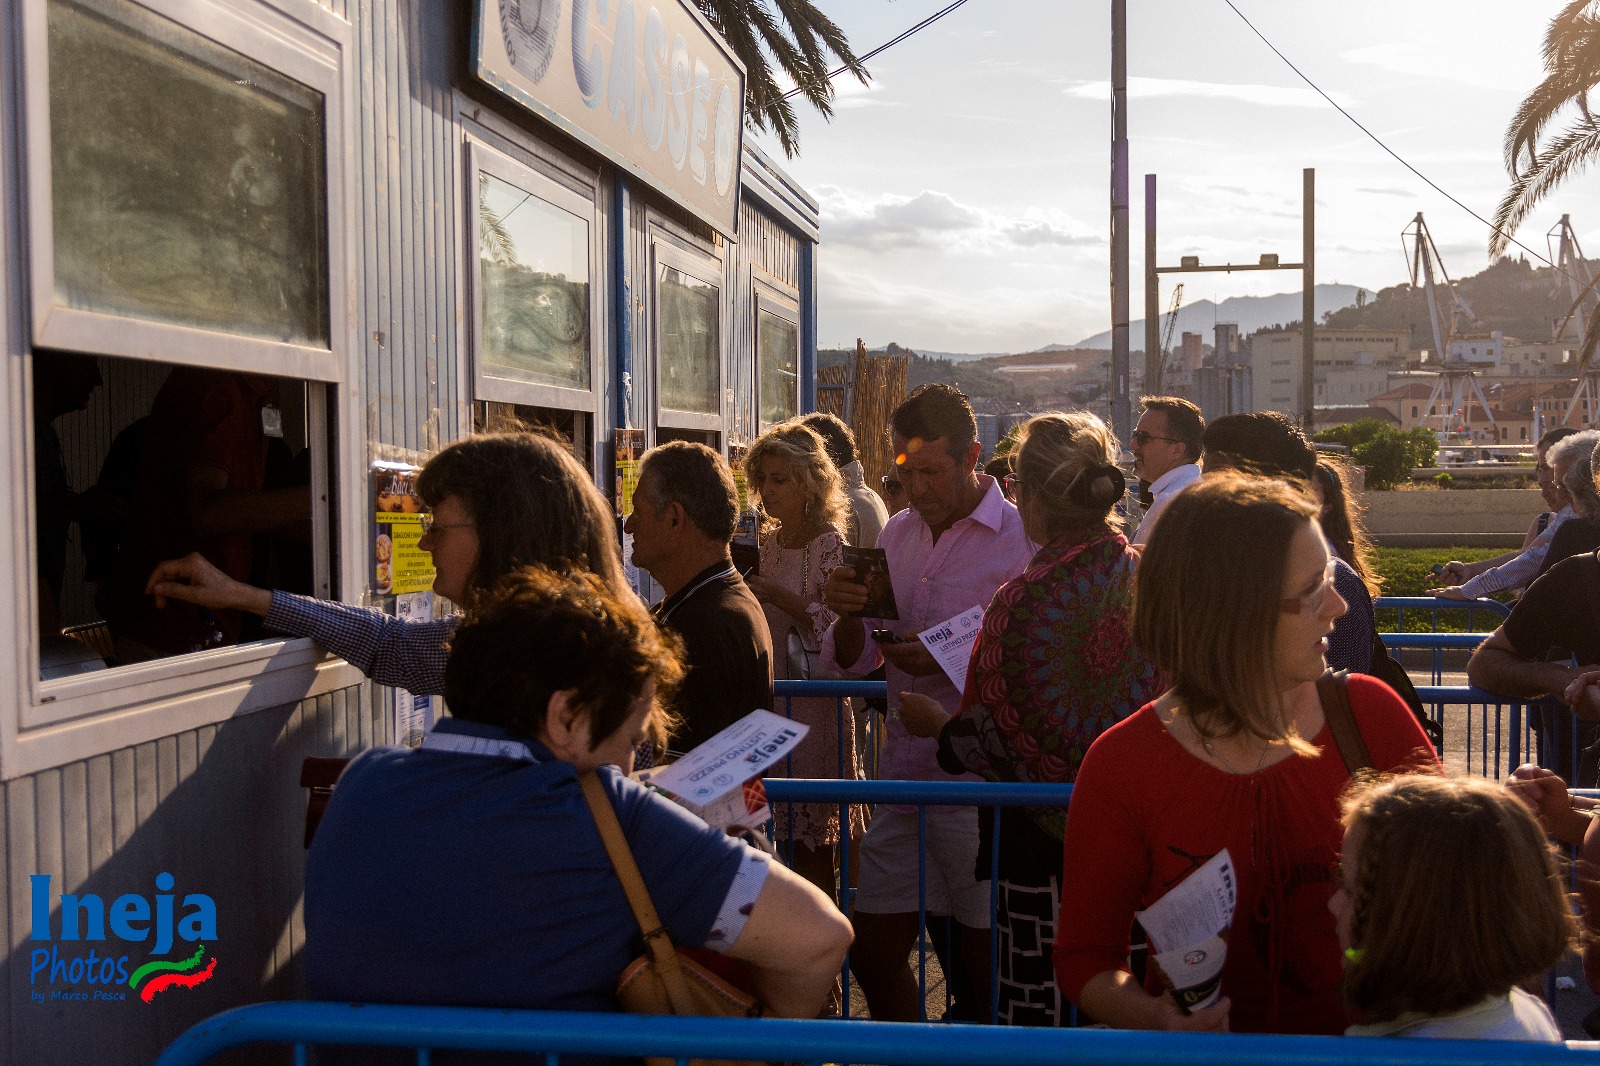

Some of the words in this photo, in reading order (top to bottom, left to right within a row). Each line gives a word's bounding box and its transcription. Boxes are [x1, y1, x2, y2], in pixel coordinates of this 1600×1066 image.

[571, 0, 712, 187] CASSE
[924, 627, 954, 646] Ineja
[939, 637, 963, 653] LISTINO
[961, 627, 980, 642] PREZZ
[725, 730, 767, 761] LISTINO
[746, 728, 798, 764] Ineja
[689, 760, 728, 783] PREZZI
